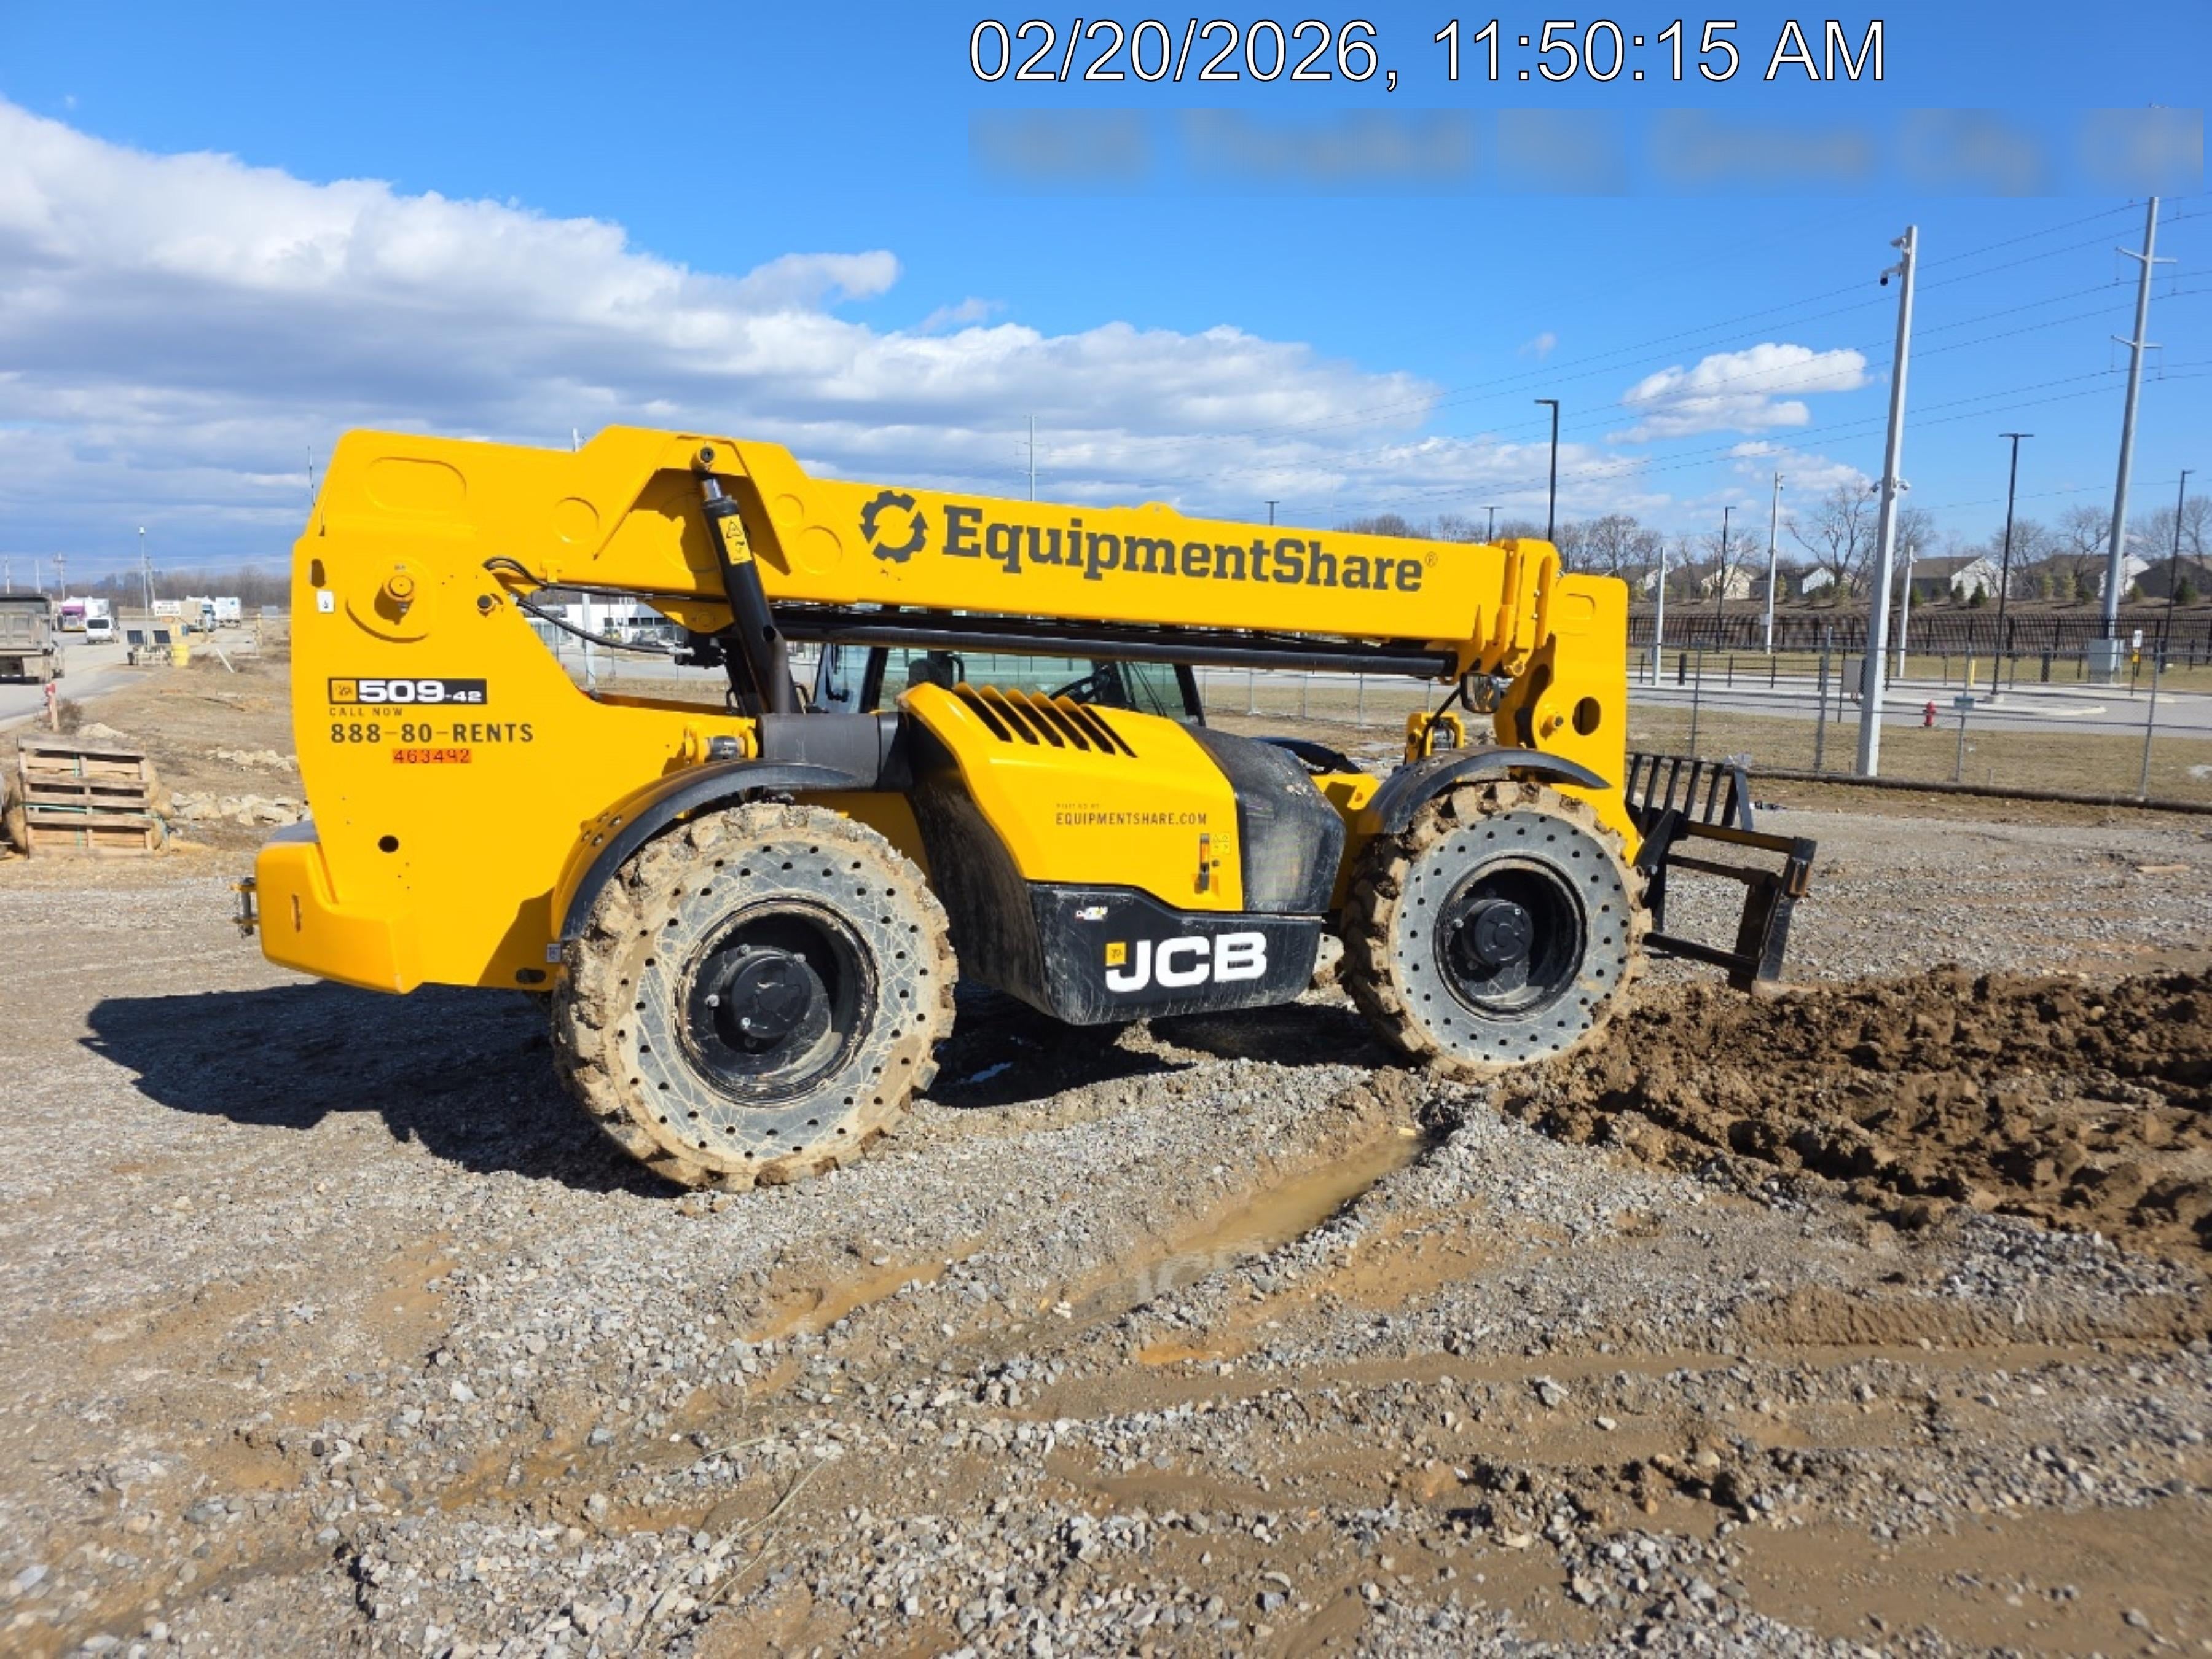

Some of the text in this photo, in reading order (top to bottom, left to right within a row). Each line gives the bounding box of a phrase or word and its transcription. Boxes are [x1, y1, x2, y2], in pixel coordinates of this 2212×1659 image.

[359, 680, 482, 702] 509-42
[329, 707, 403, 716] CALL NOW
[331, 723, 533, 743] 888-80-RENTS
[394, 749, 469, 763] 463492
[1056, 812, 1207, 825] EQUIPMENTSHARE.COM
[1106, 932, 1267, 992] JCB
